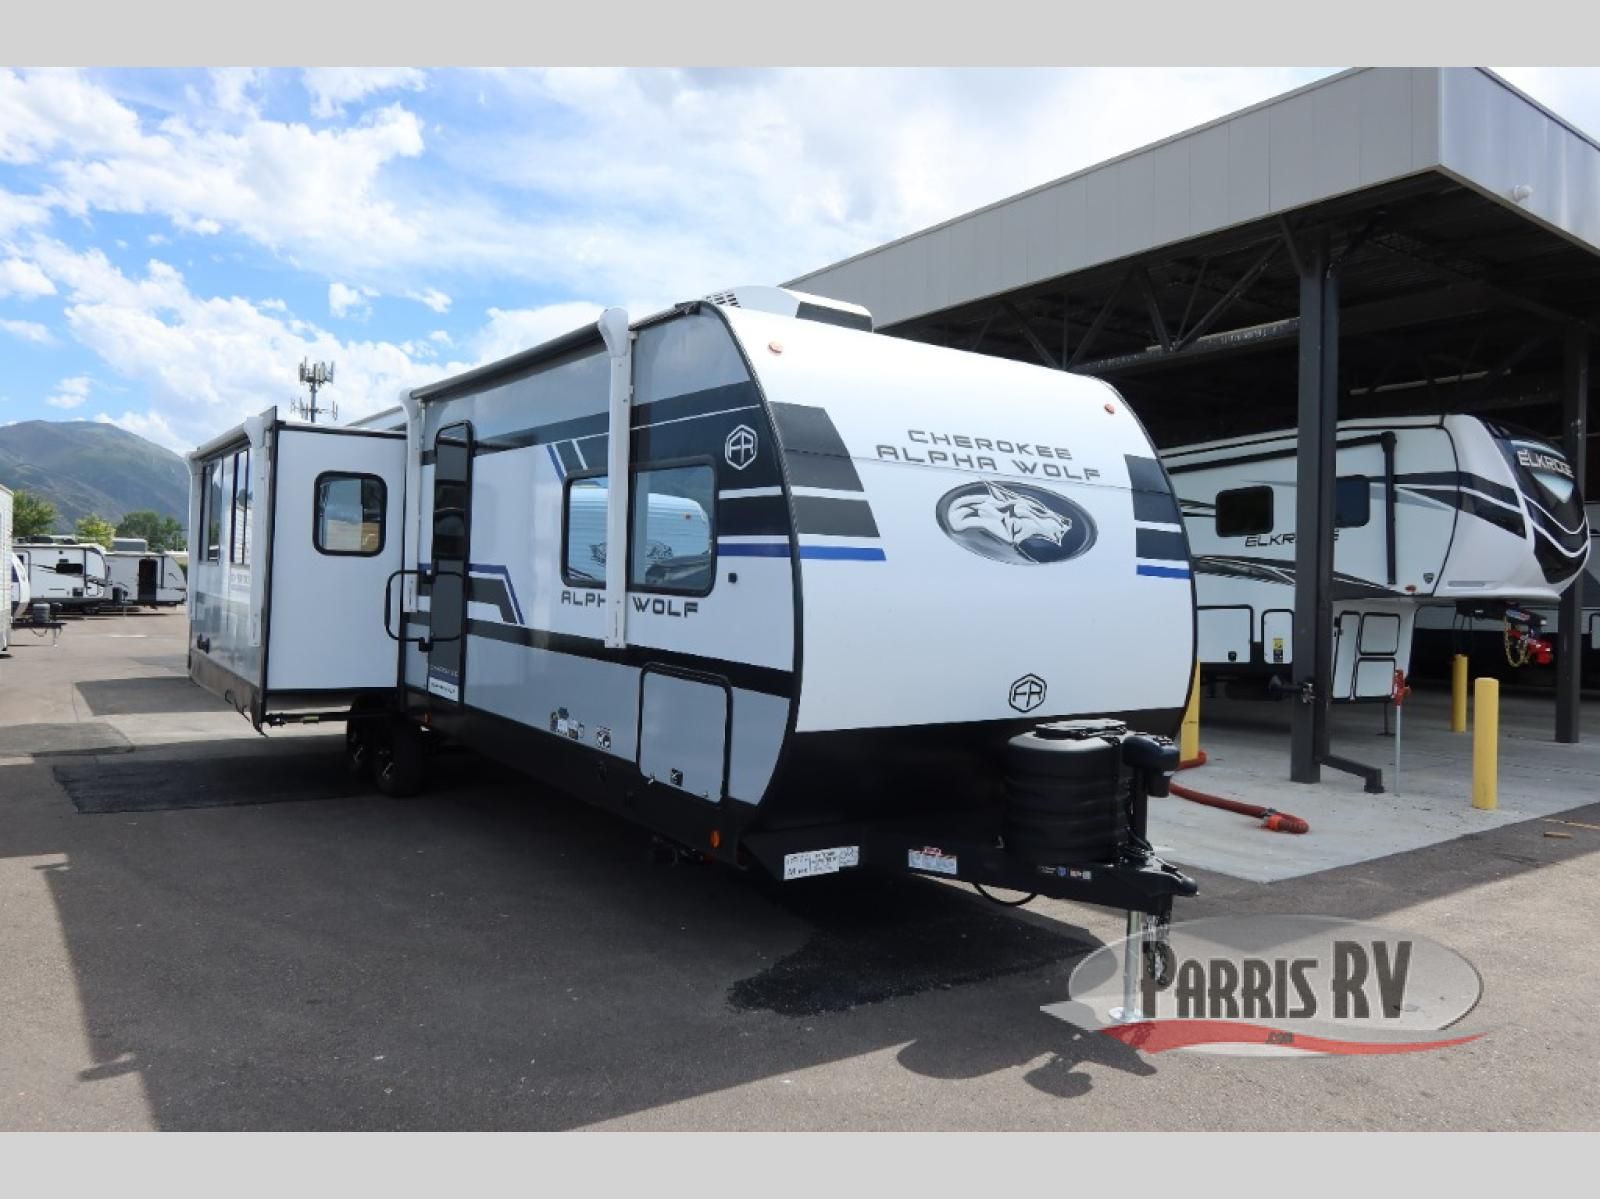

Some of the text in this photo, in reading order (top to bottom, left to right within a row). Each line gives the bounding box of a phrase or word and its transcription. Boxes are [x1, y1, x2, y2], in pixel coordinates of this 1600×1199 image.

[907, 429, 1073, 460] CHEROKEE
[876, 444, 1101, 480] ALPHA WOLF
[561, 590, 699, 618] ALPH WOLF
